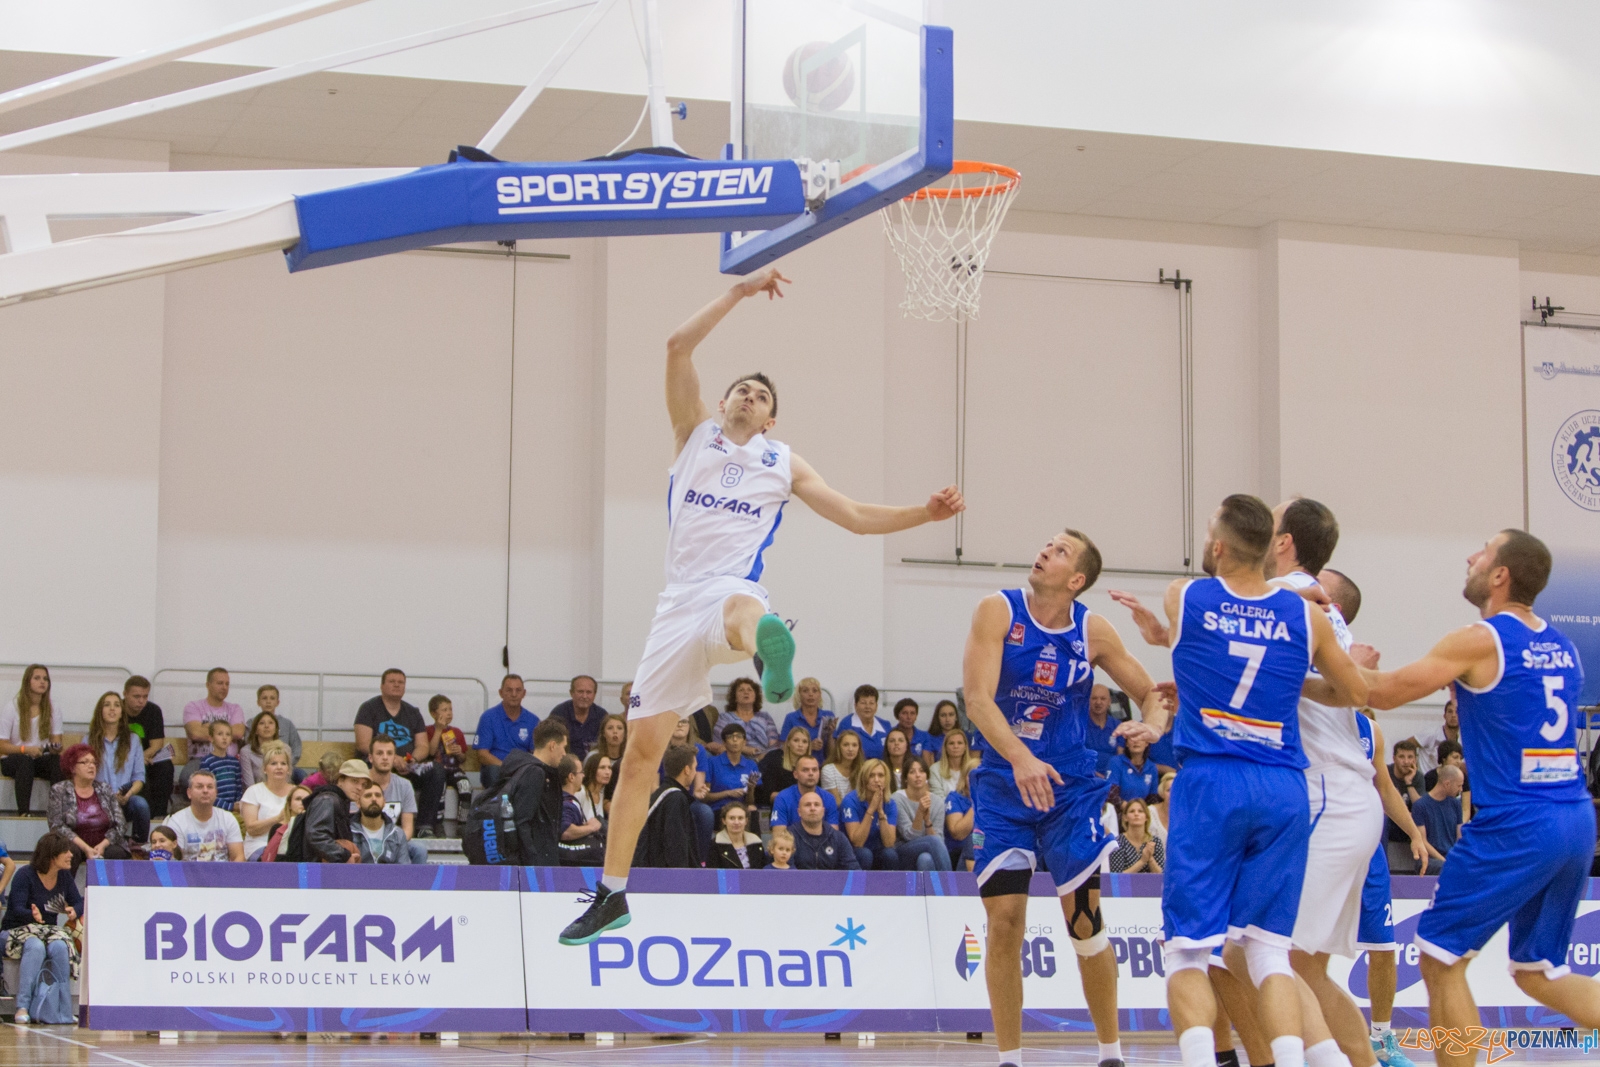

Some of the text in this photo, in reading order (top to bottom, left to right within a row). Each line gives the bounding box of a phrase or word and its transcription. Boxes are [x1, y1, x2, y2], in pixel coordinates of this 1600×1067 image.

[496, 166, 774, 213] SPORTSYSTEM
[1561, 420, 1579, 442] KLUB
[720, 463, 744, 488] 8
[1556, 453, 1597, 507] POLITECHNIKI
[1220, 602, 1276, 620] GALERIA
[1066, 658, 1092, 688] 12
[1228, 640, 1267, 710] 7
[1539, 675, 1569, 742] 5
[170, 970, 431, 986] POLSKI PRODUCENT LEKÓW
